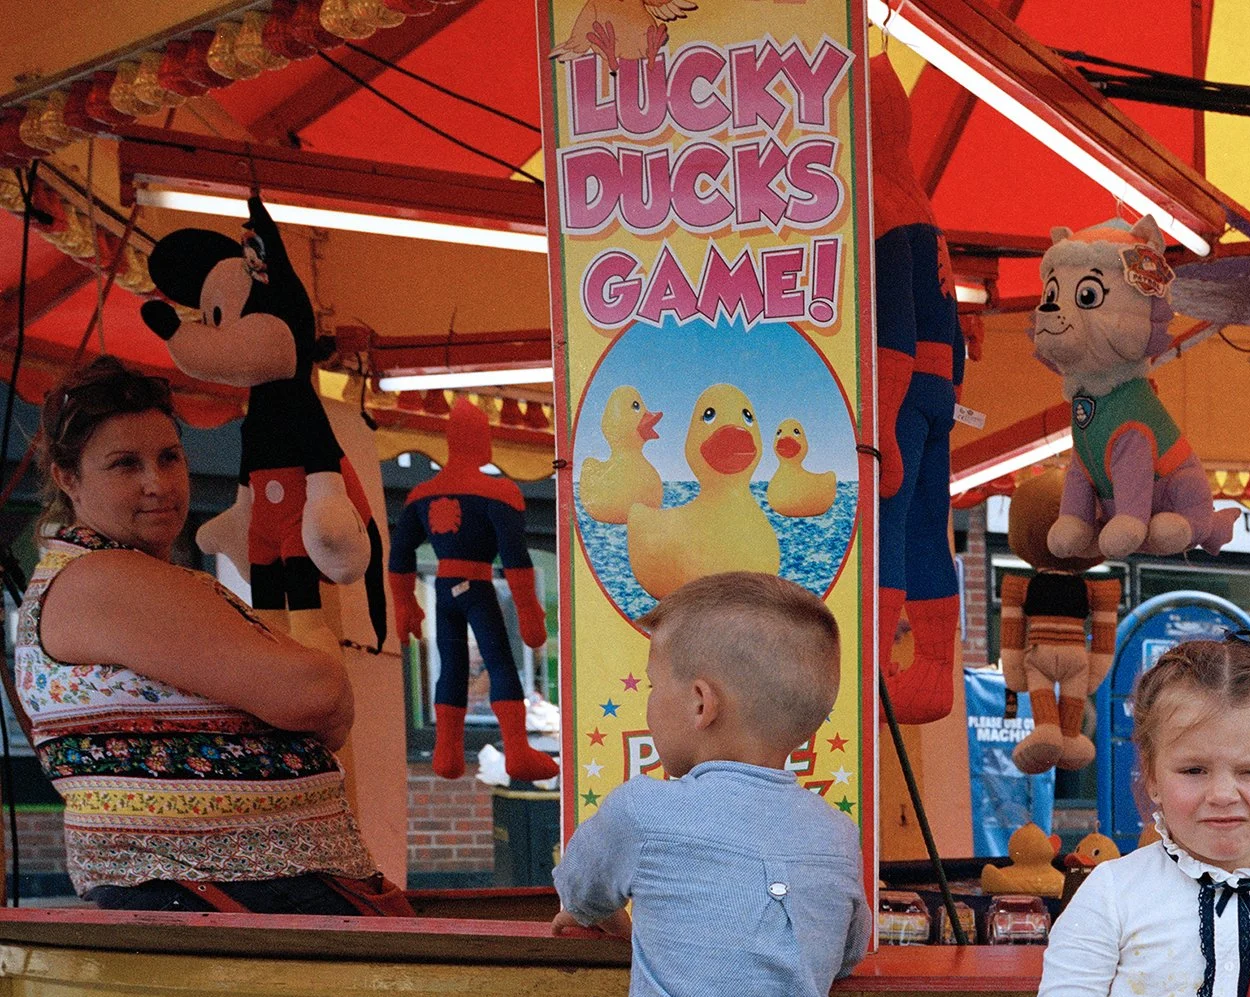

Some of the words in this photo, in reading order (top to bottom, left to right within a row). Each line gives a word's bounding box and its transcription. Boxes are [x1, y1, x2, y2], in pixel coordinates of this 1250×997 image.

[569, 36, 853, 139] LUCKY
[559, 135, 842, 232] DUCKS
[582, 239, 840, 327] GAME!
